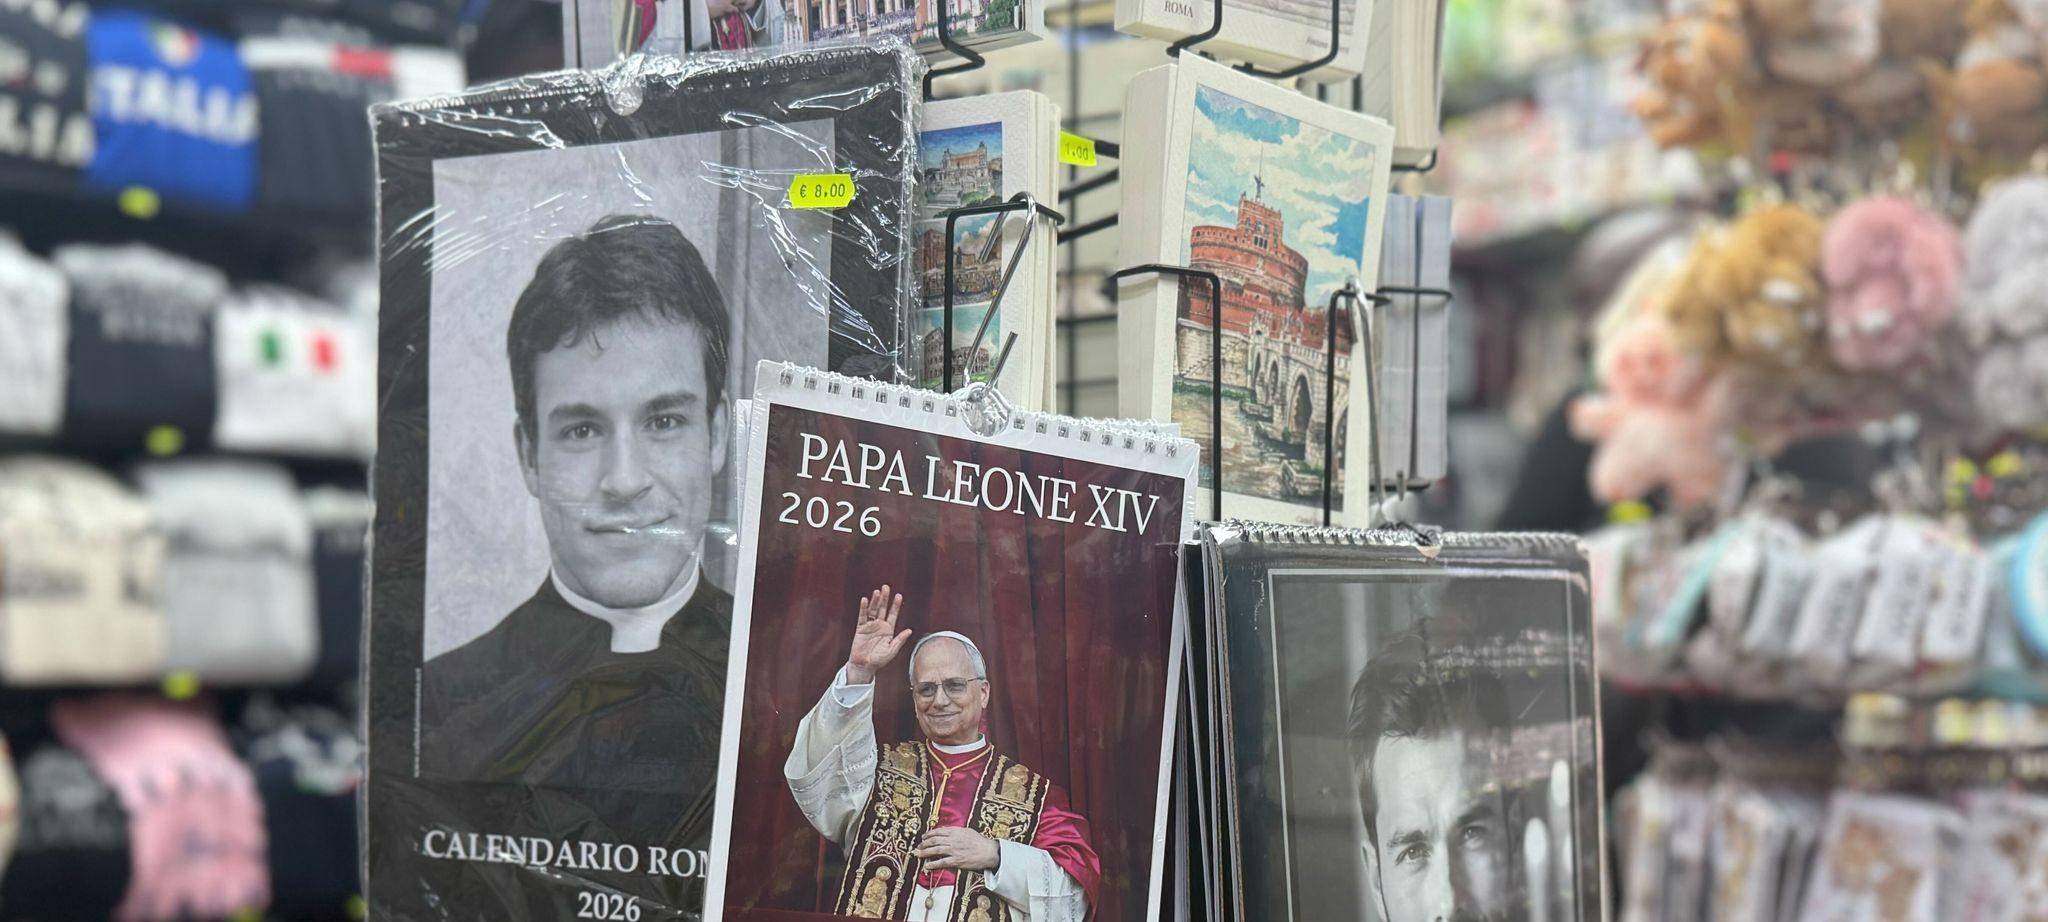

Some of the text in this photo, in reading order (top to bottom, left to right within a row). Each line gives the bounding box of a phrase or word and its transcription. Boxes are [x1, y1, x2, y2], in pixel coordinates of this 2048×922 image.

[1164, 0, 1194, 18] ROMA
[799, 183, 846, 198] € 8,00
[796, 432, 1160, 536] PAPA LEONE XIV
[778, 491, 882, 537] 2026
[424, 829, 640, 873] CALENDARIO
[577, 891, 641, 922] 2026
